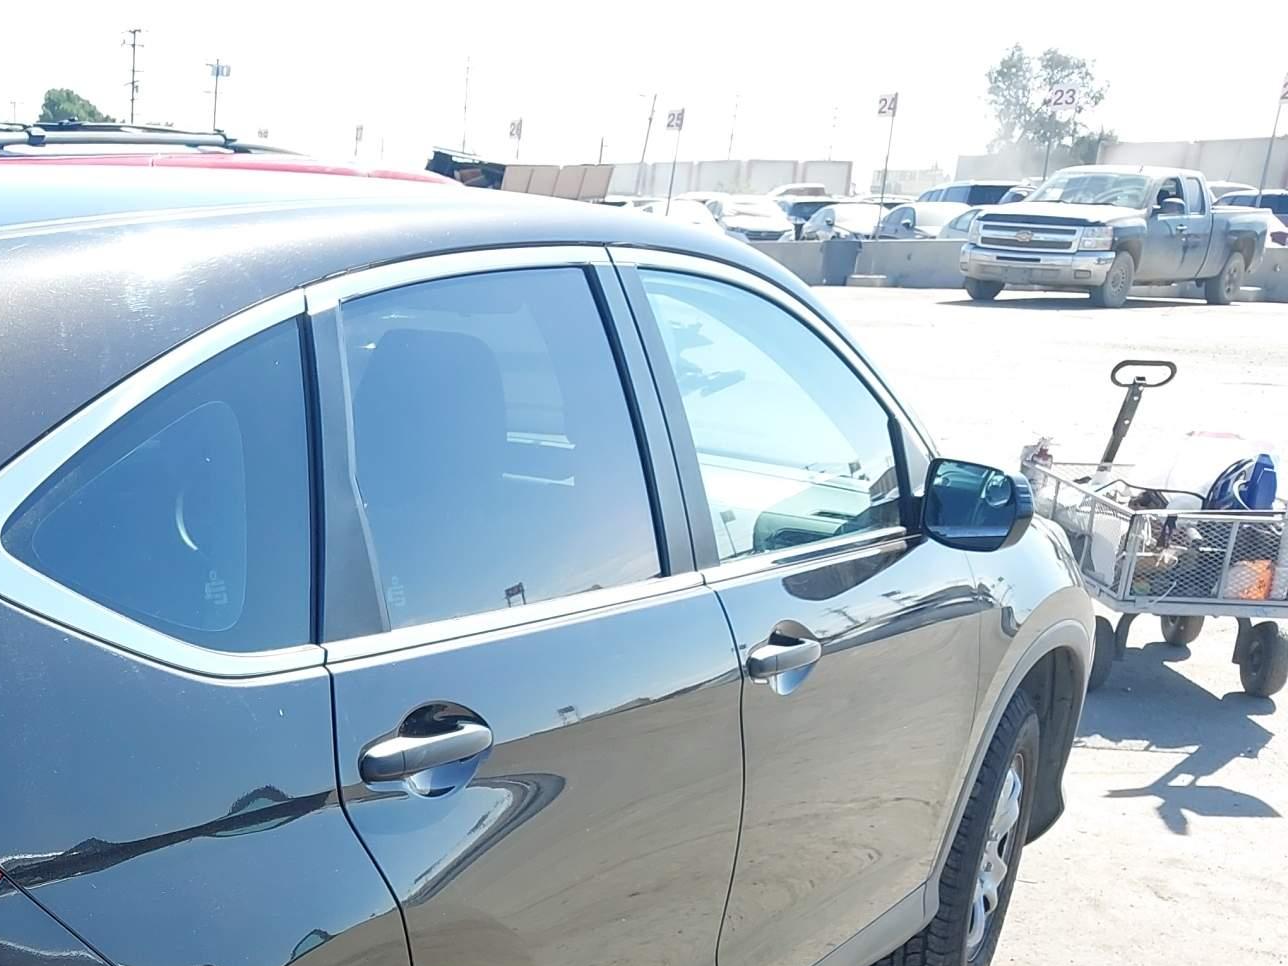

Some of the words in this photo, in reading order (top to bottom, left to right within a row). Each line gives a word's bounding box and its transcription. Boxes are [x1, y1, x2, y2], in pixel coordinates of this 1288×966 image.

[877, 97, 897, 116] 24
[1052, 88, 1076, 106] 23
[666, 111, 683, 130] 25
